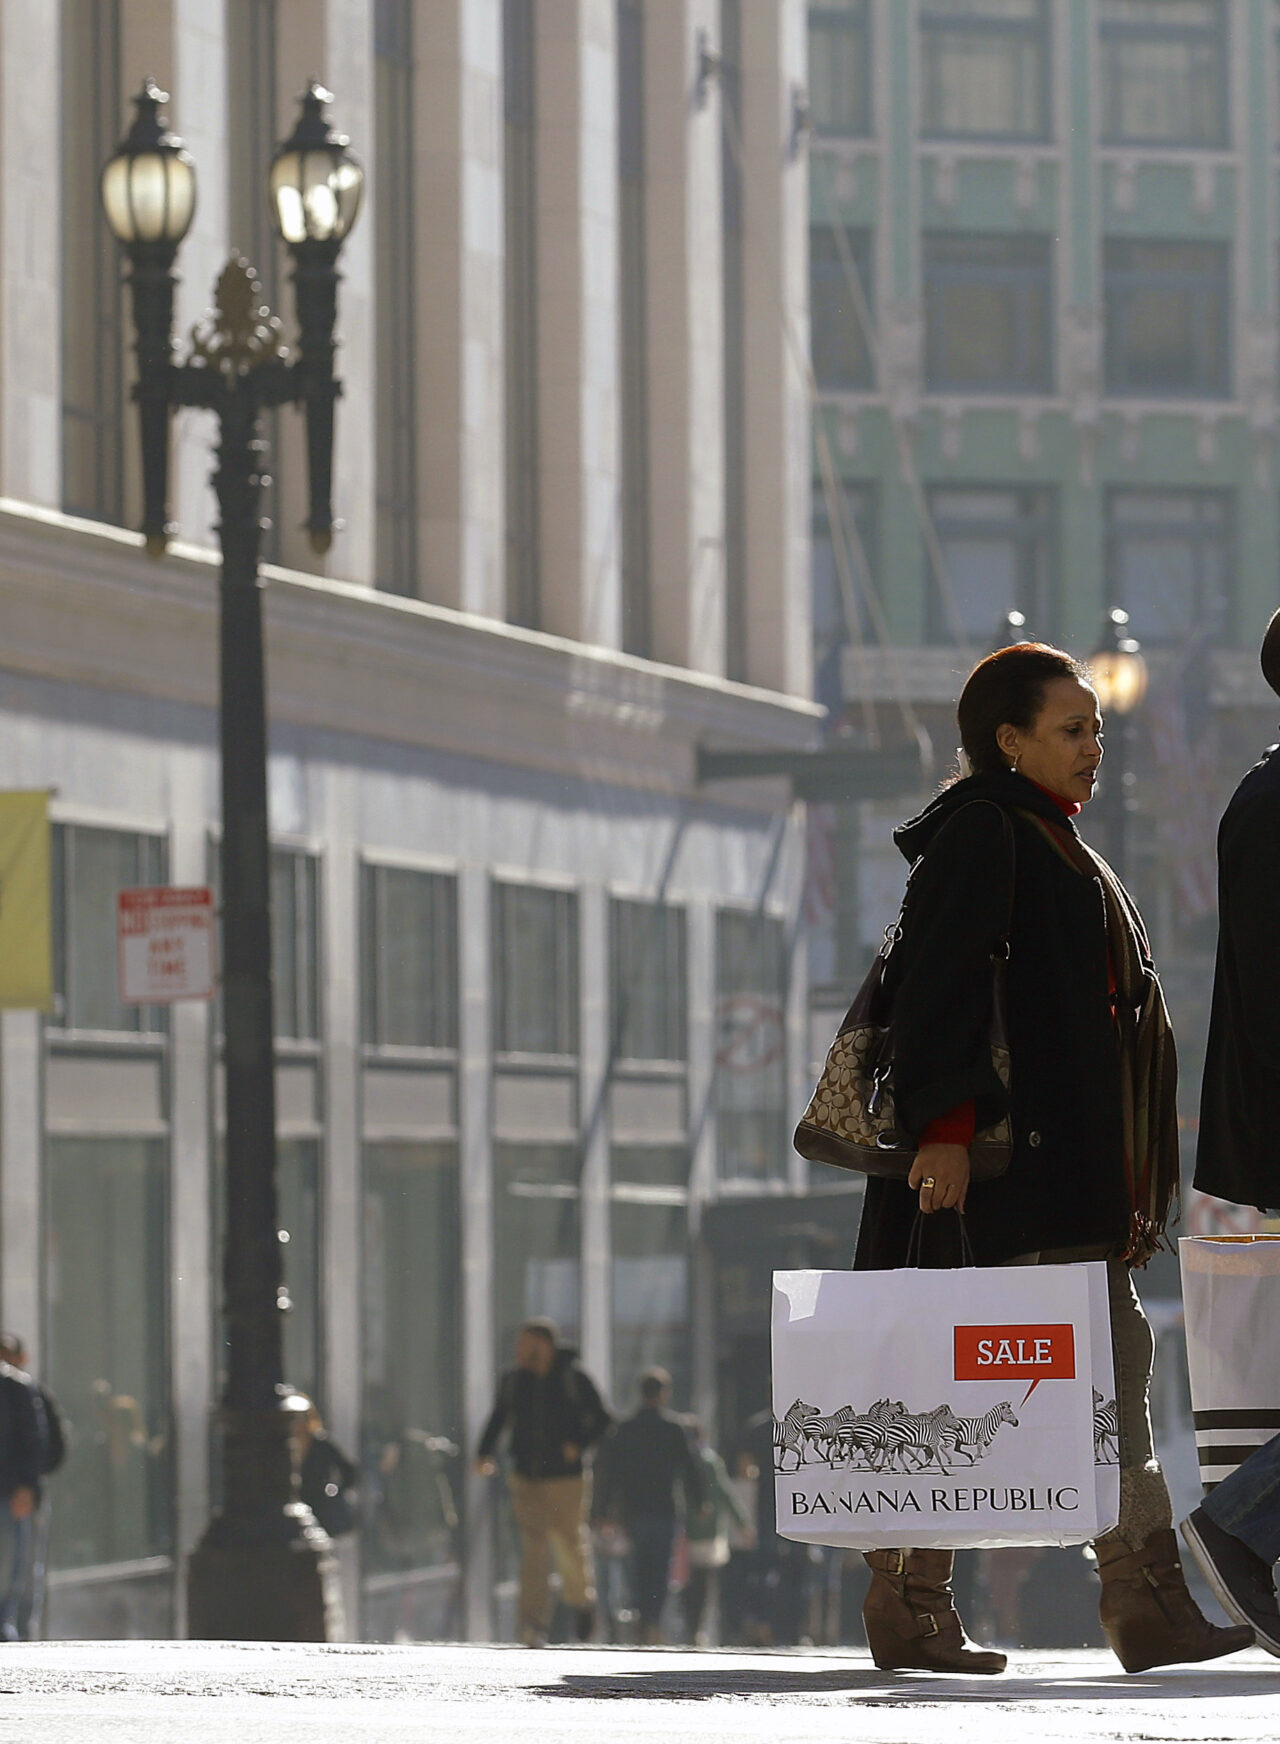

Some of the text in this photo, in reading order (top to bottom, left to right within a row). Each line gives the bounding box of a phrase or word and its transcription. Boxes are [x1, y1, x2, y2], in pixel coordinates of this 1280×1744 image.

[977, 1339, 1052, 1365] SALE
[791, 1486, 1079, 1515] BANANA REPUBLIC
